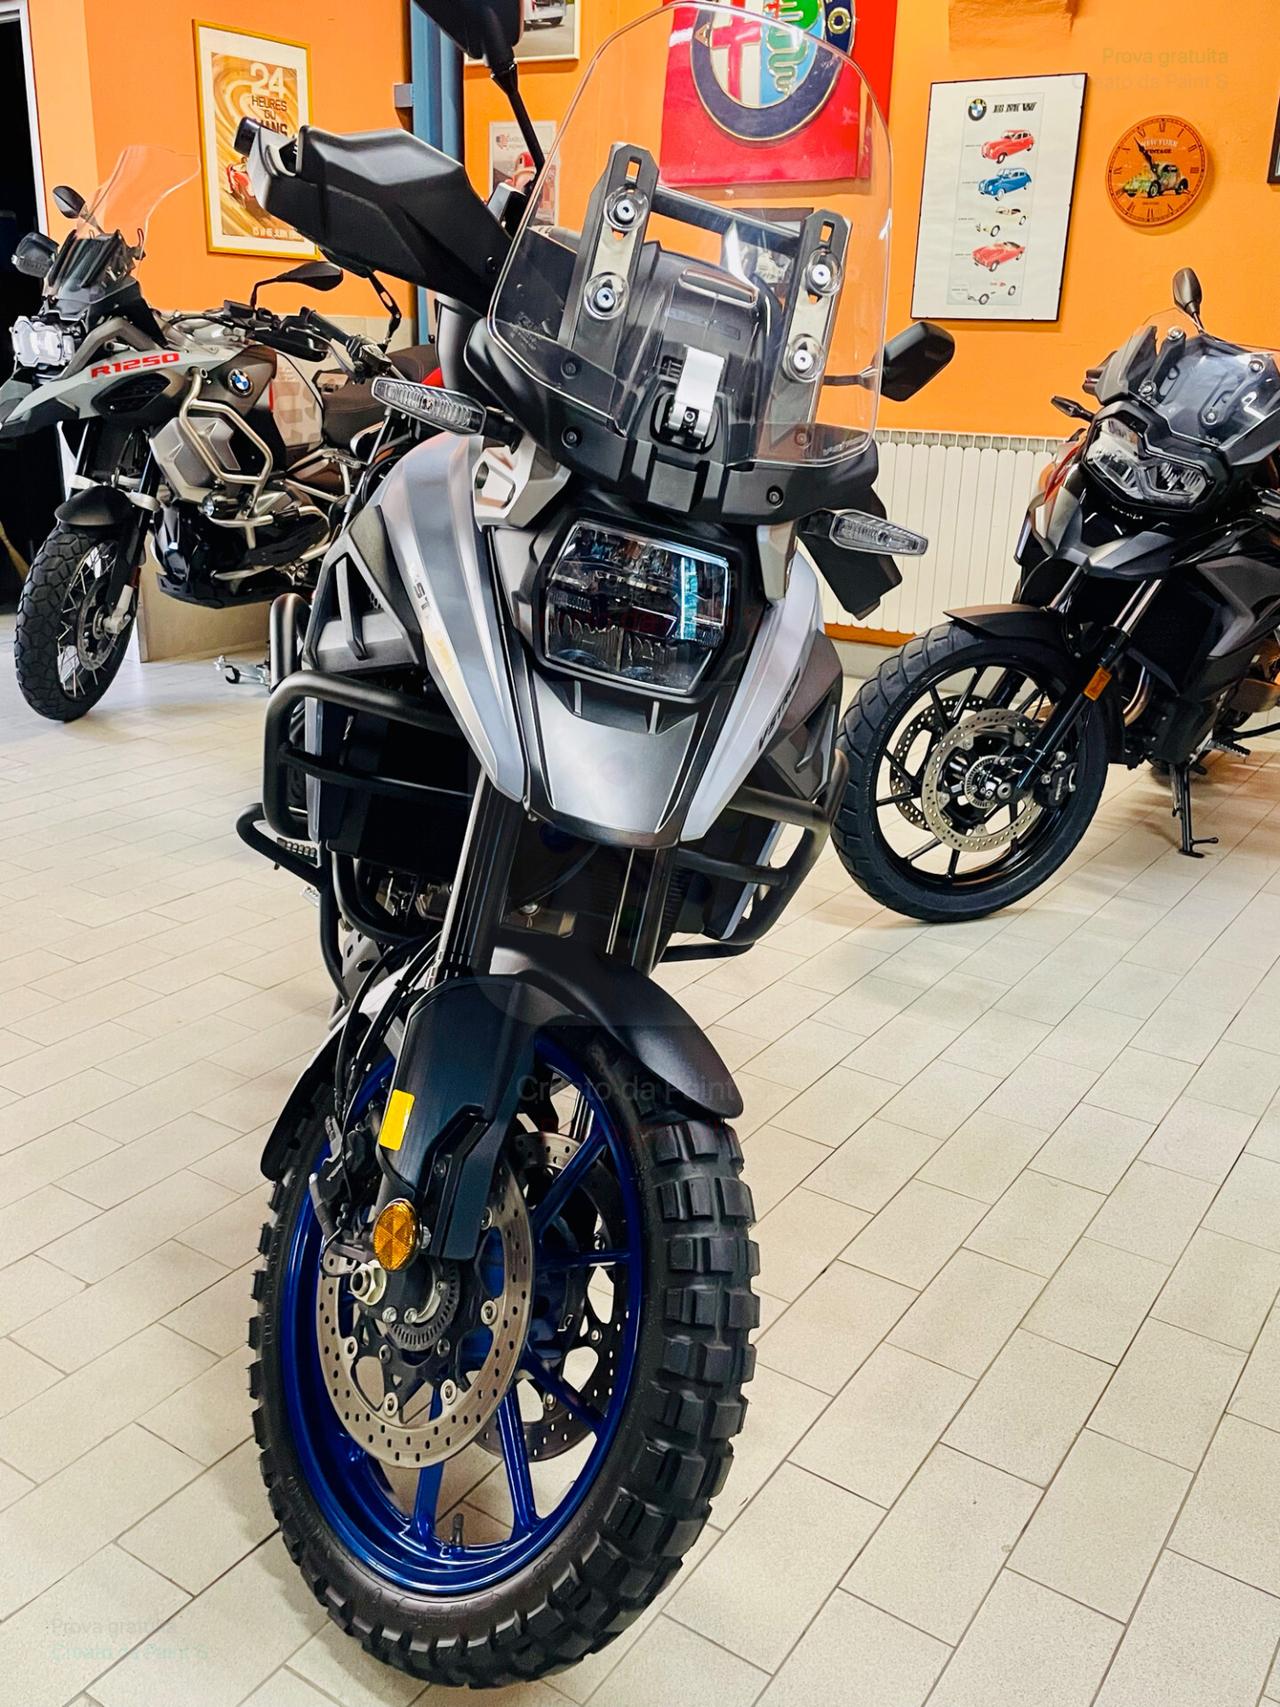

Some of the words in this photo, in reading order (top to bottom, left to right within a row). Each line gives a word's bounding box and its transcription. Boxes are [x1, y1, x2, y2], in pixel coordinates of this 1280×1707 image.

[250, 62, 286, 100] 24
[251, 95, 288, 112] HEURES
[260, 119, 288, 137] ANS
[91, 353, 180, 379] R1250
